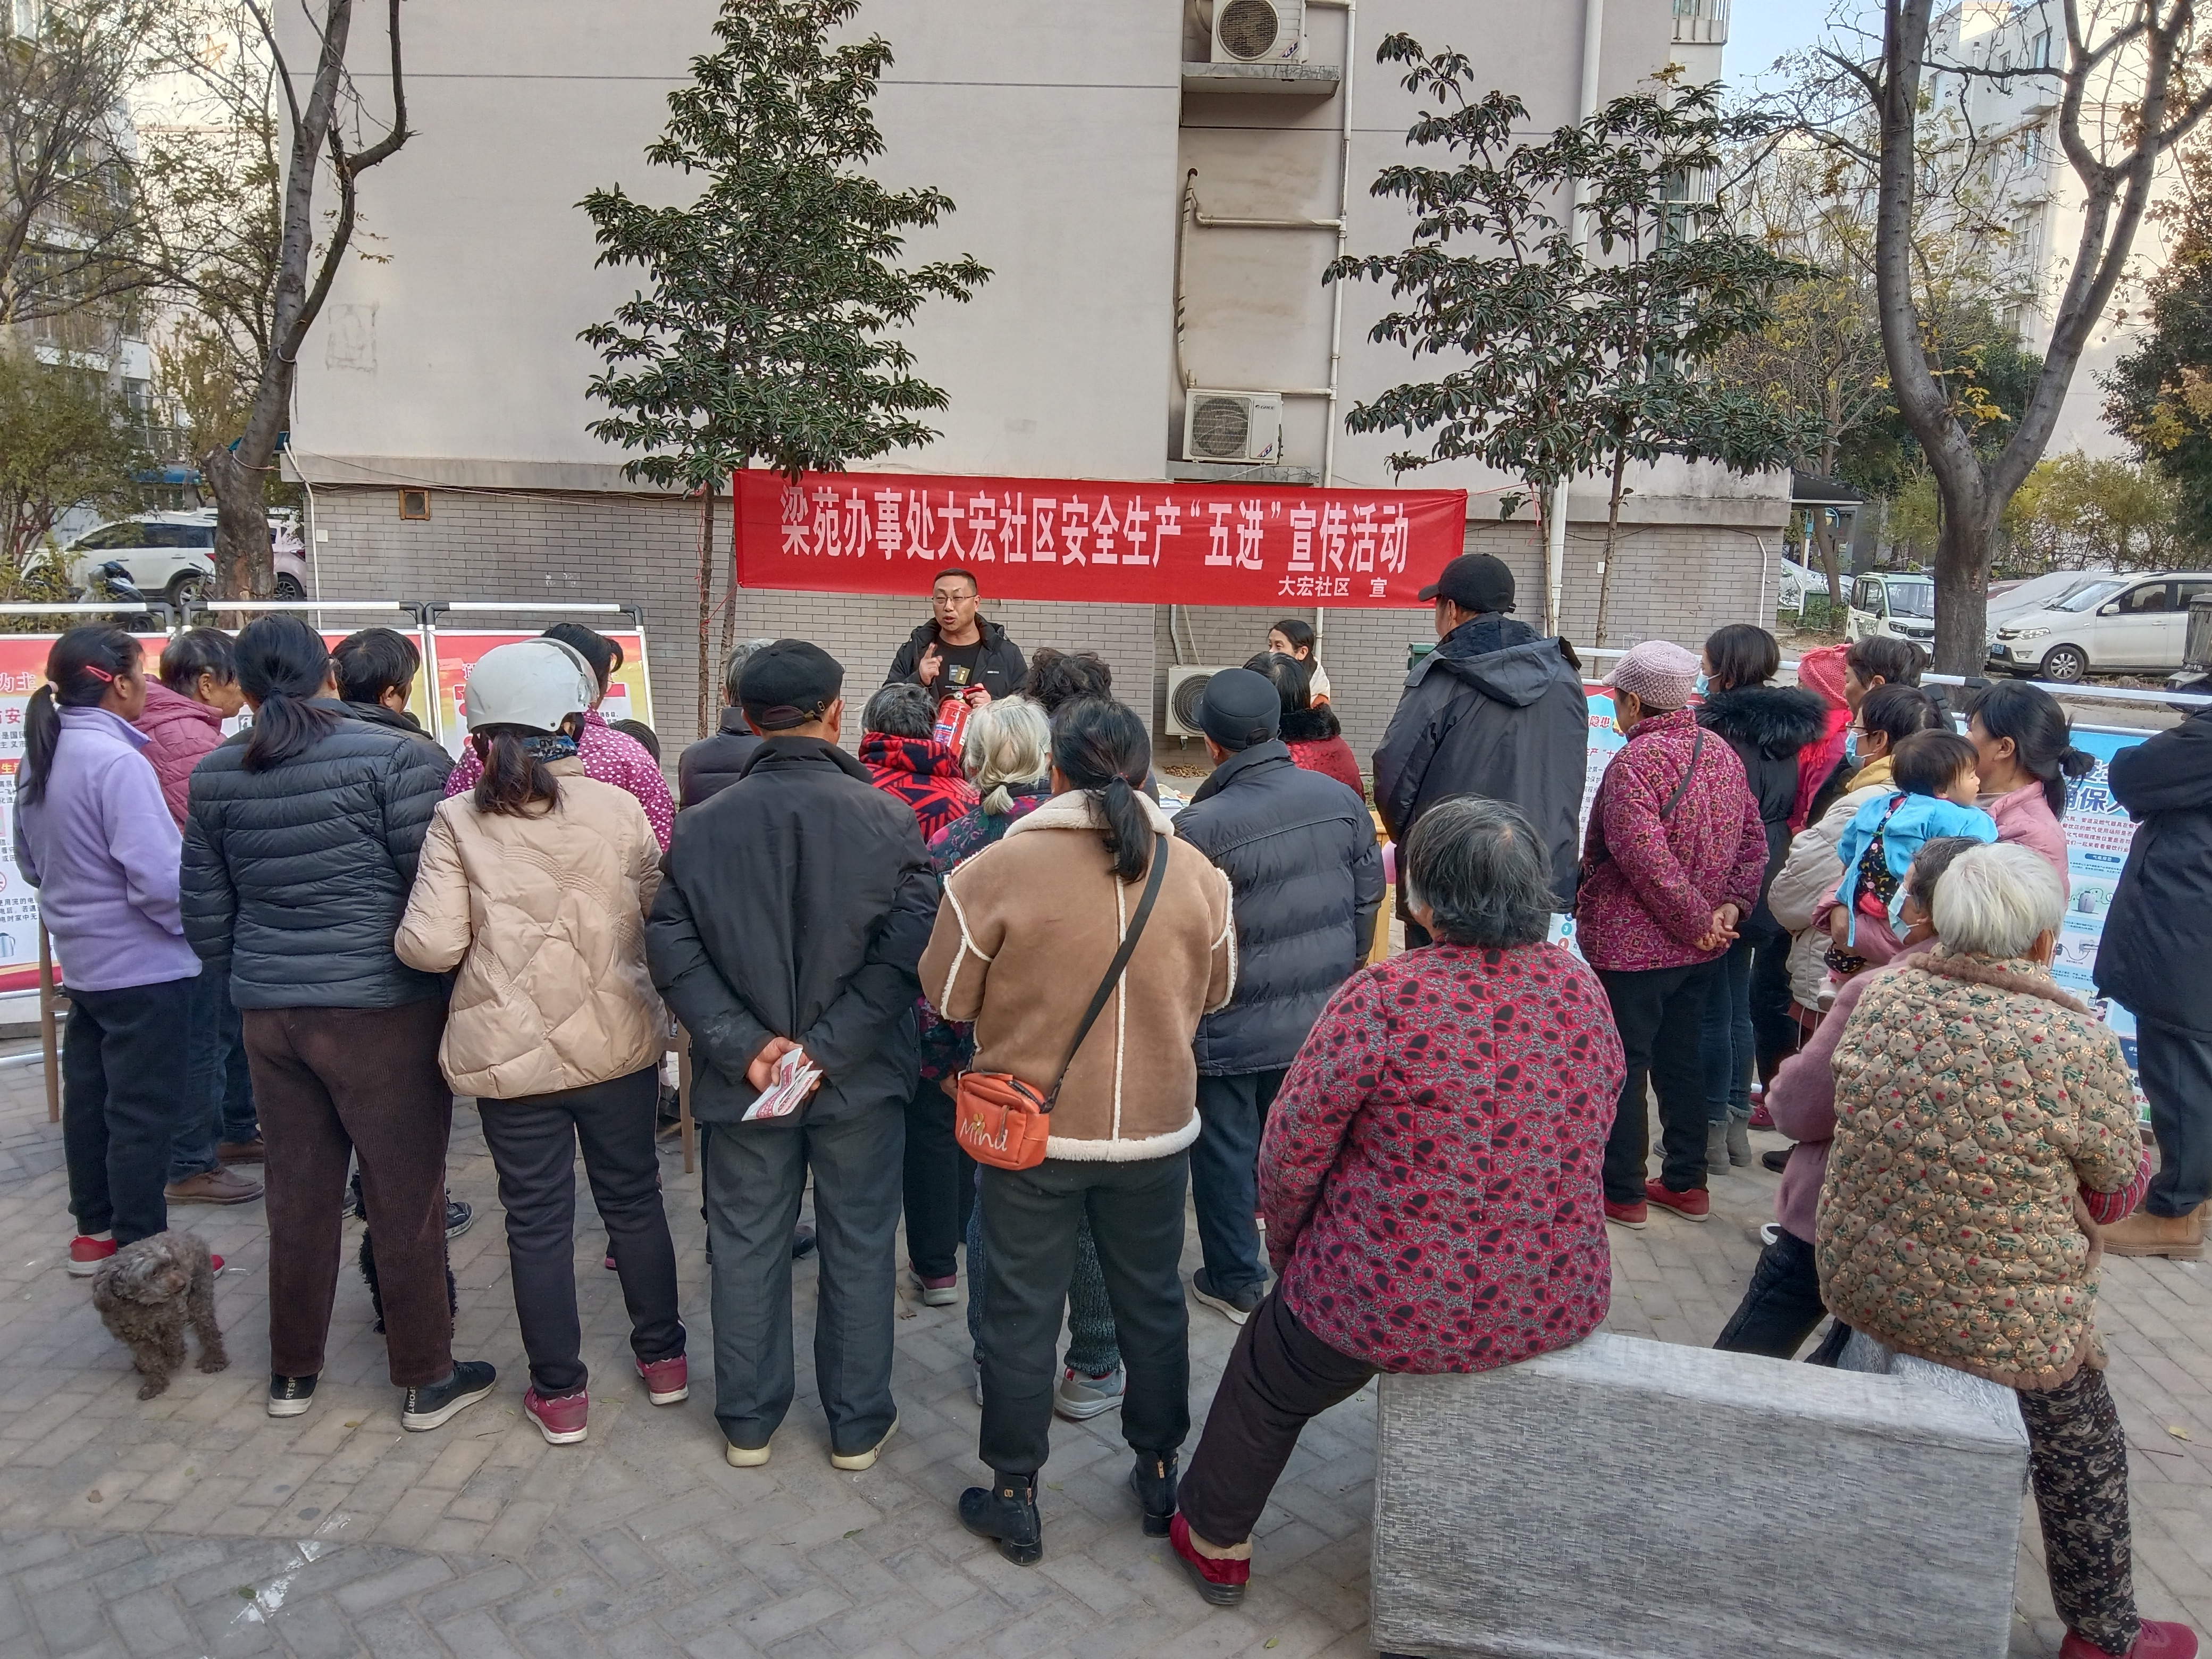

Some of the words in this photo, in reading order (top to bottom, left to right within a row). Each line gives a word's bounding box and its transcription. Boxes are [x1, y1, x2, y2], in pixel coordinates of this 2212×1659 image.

[1278, 575, 1350, 597] 大宏社区
[1369, 577, 1387, 597] 宣
